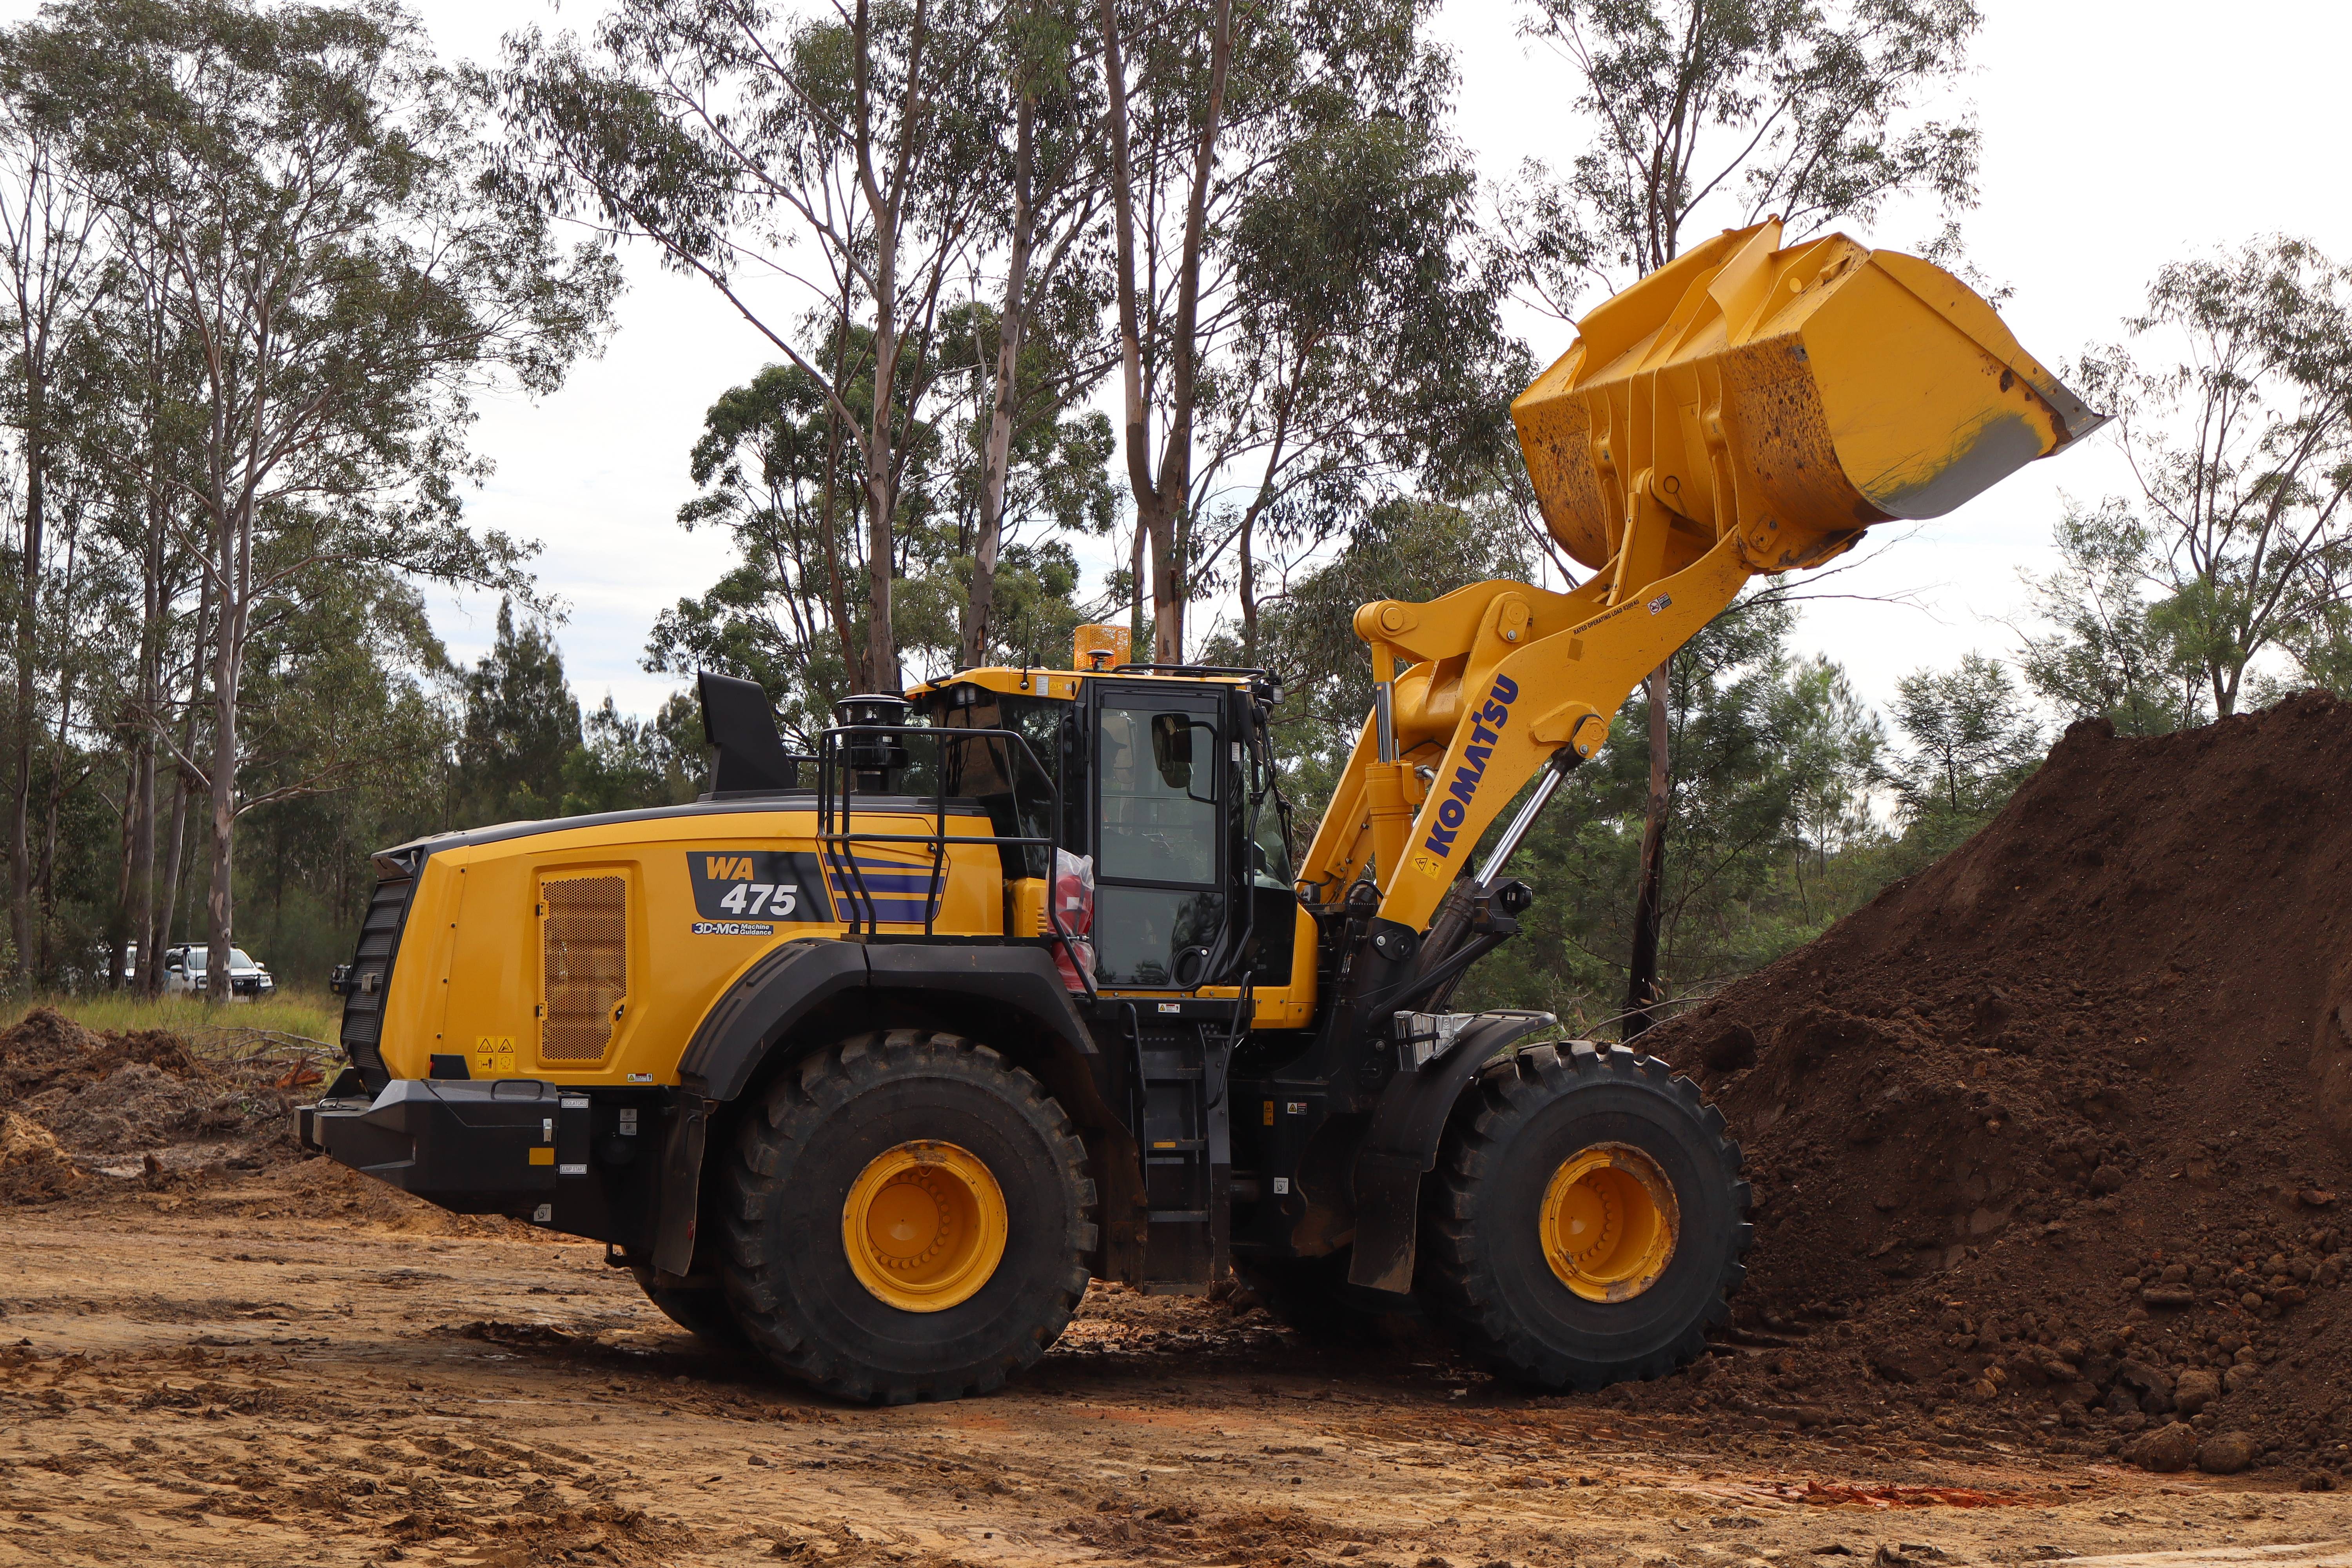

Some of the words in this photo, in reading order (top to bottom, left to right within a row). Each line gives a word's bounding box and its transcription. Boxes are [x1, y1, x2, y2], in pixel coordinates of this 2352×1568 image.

[1573, 624, 1588, 635] RATED
[1588, 613, 1612, 628] OPERATING
[1612, 608, 1623, 617] LOAD
[1623, 602, 1634, 611] 8300
[1425, 673, 1519, 858] KOMATSU
[706, 856, 754, 881] WA
[720, 883, 798, 916] 475
[694, 922, 740, 935] 3D-MG
